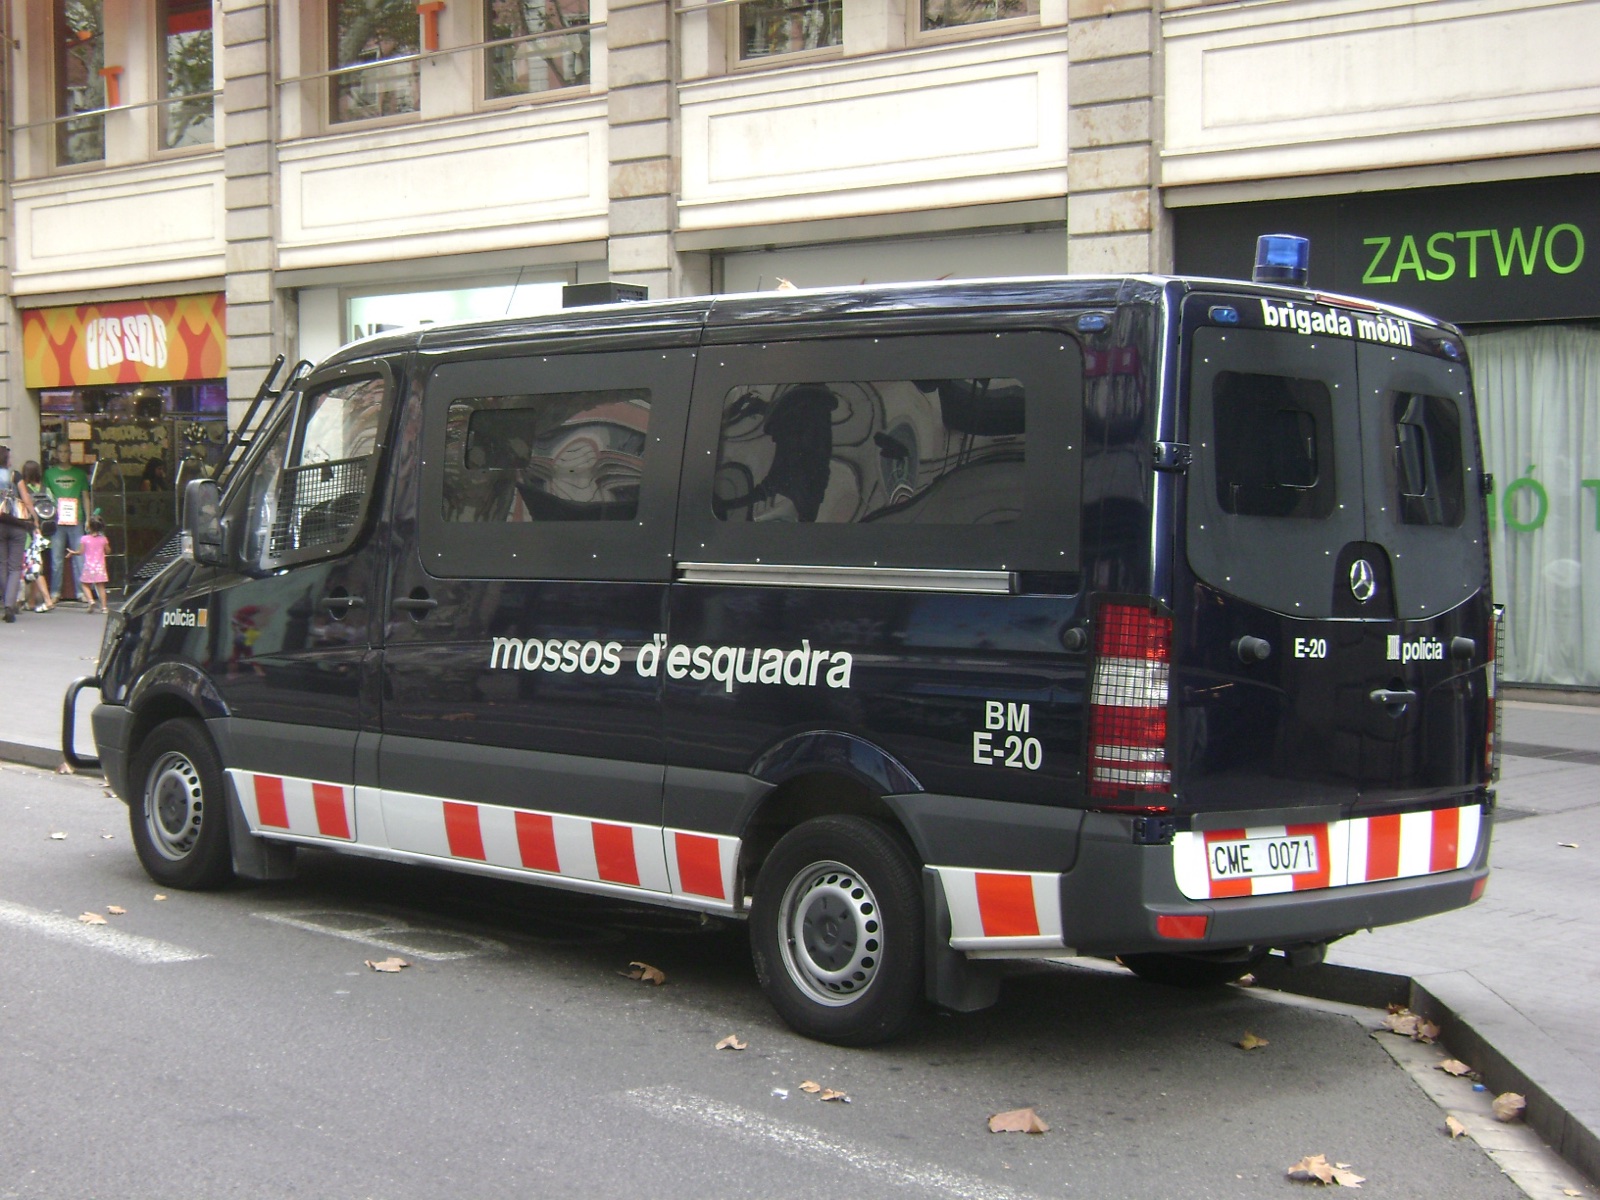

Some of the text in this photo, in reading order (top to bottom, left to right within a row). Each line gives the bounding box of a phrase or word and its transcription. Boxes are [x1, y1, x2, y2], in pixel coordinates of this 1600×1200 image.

[1362, 223, 1585, 284] ZASTWO
[1260, 298, 1413, 347] brigada mòbil
[162, 608, 196, 628] policia
[490, 632, 853, 693] mossos d'esquadra
[1294, 637, 1327, 659] E-20
[1402, 636, 1443, 665] policia
[985, 700, 1030, 733] BM
[973, 731, 1042, 771] E-20
[1214, 840, 1312, 875] CME 0071
